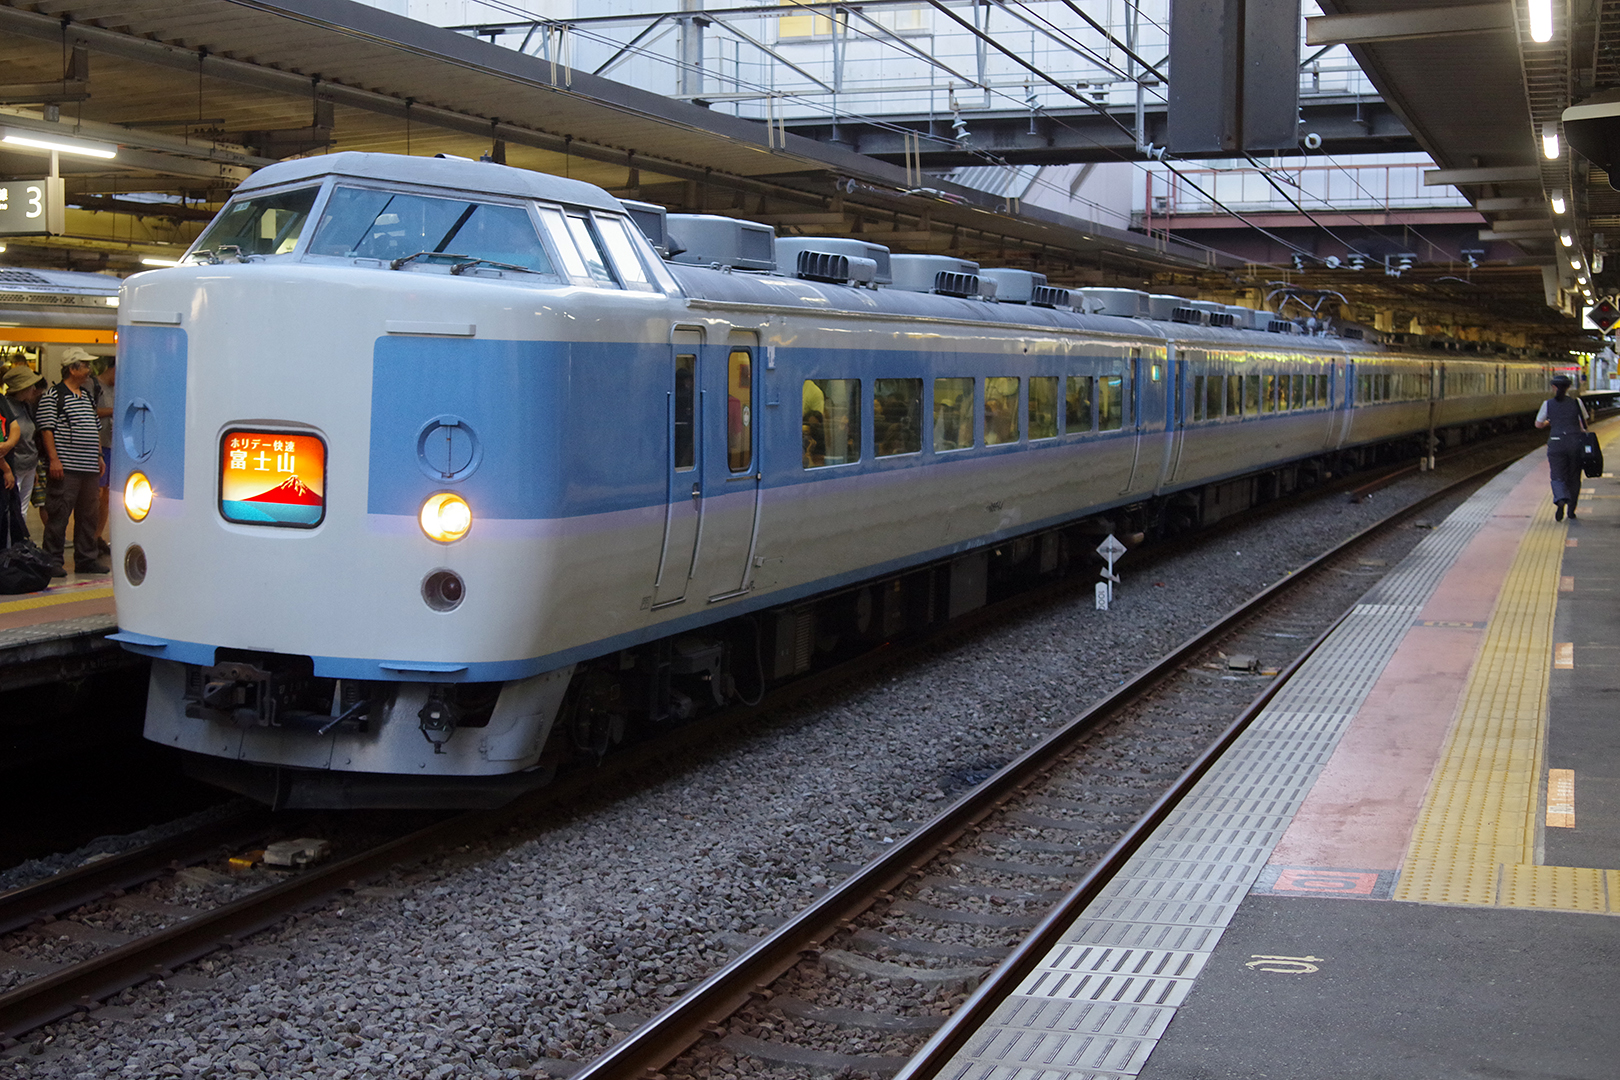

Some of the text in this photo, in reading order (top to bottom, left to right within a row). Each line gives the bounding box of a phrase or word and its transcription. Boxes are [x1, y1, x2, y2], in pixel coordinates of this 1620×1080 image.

[25, 186, 42, 218] 3
[230, 438, 295, 452] ホリデー快速
[229, 449, 295, 473] 富士山
